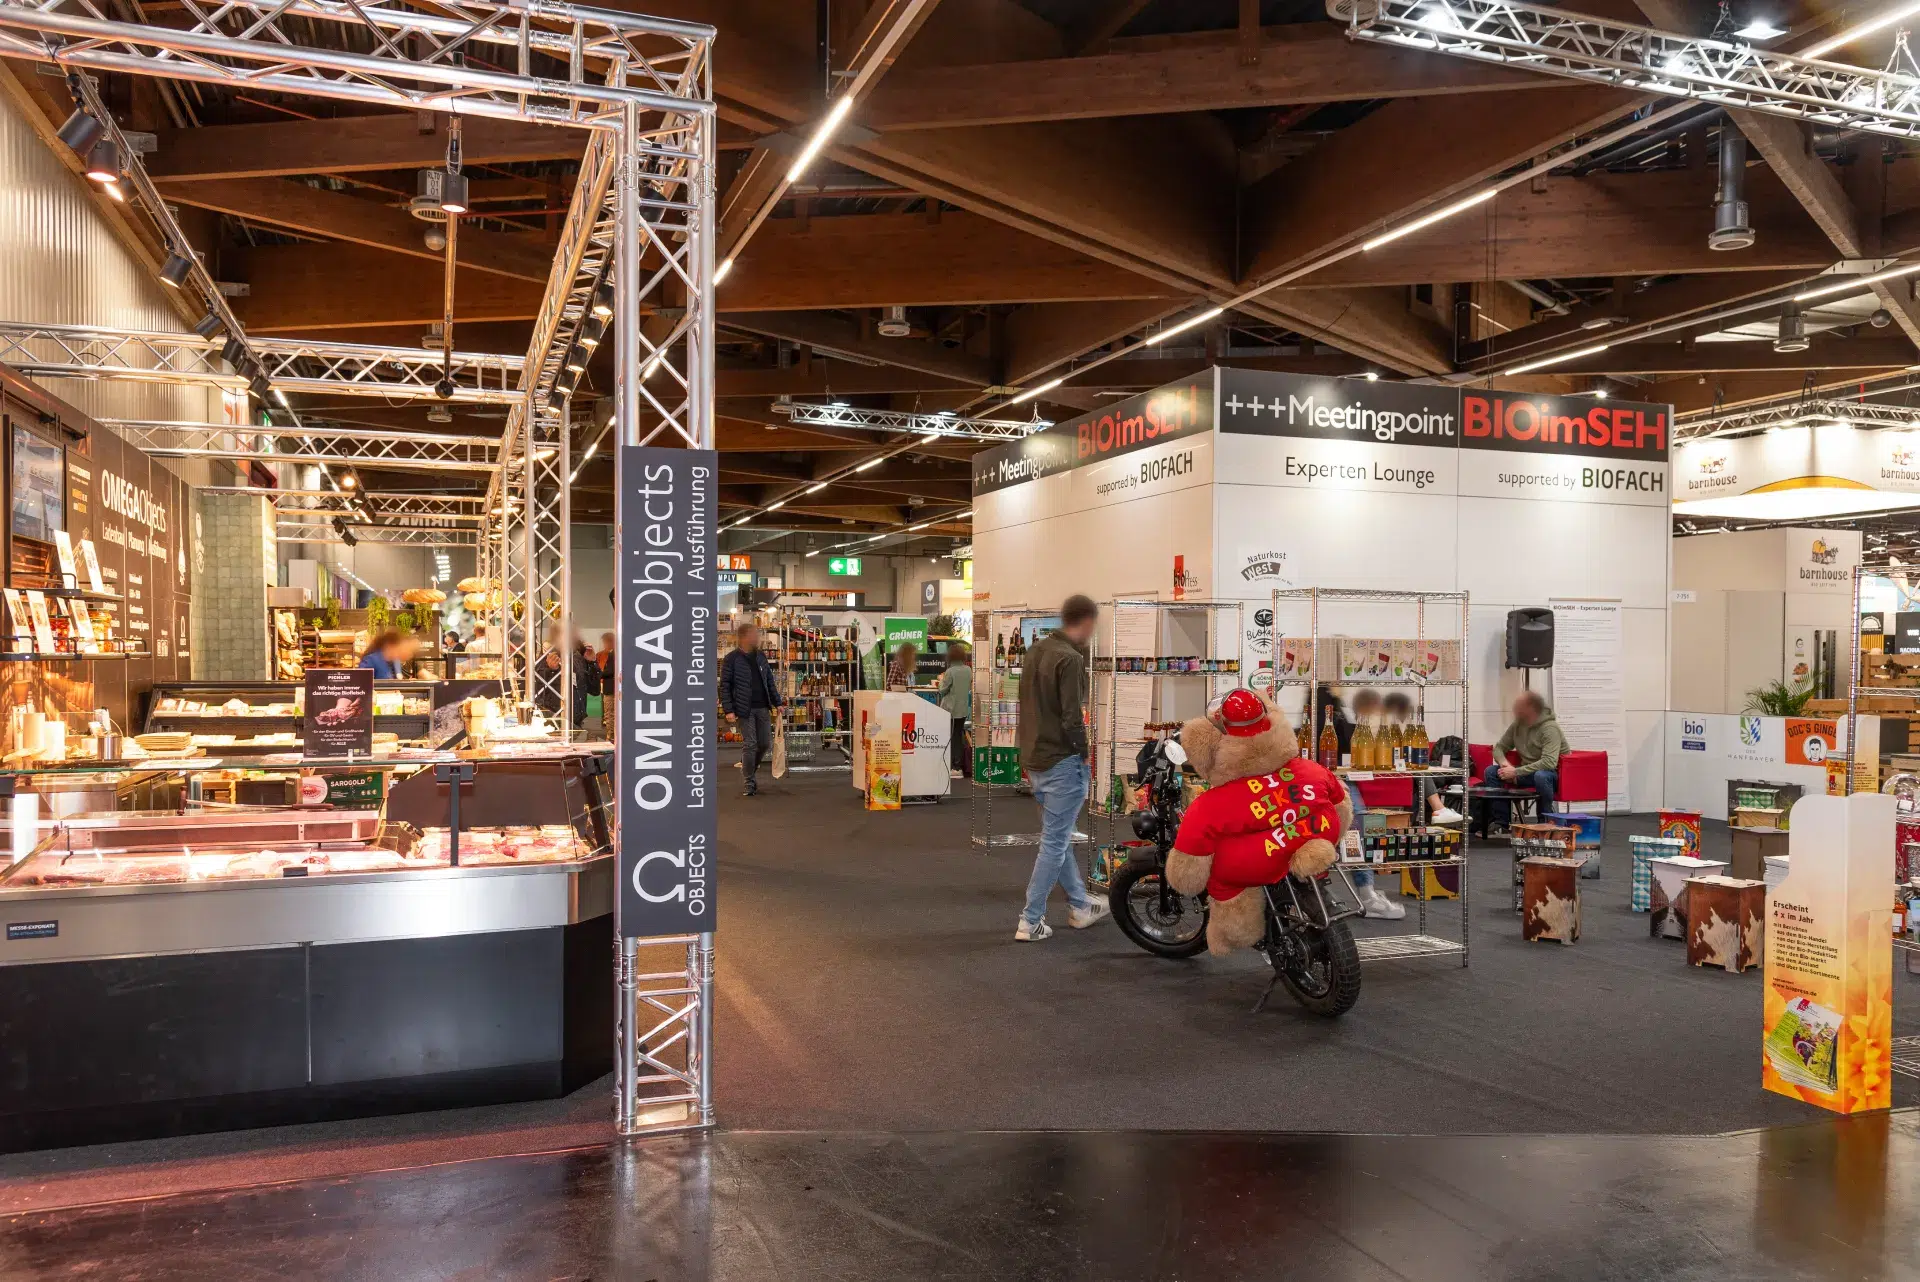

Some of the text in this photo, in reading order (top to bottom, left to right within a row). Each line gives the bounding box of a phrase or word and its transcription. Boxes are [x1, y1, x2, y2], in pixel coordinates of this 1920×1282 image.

[1077, 384, 1197, 459] BIOimSEH
[1464, 396, 1665, 450] BIOimSEH
[1096, 451, 1192, 496] supported by BIOFACH
[1285, 456, 1435, 488] Experten Lounge
[1498, 467, 1664, 492] supported by BIOFACH
[1688, 474, 1737, 490] barnhouse
[1881, 466, 1920, 481] barnhous
[101, 468, 167, 536] OMEGAObjects
[686, 466, 710, 581] Ausführung
[733, 557, 747, 570] 7A
[1247, 550, 1287, 564] Naturkost
[1244, 562, 1274, 579] West
[1800, 566, 1848, 581] barnhouse
[632, 464, 684, 811] OMEGAObjects
[888, 629, 923, 641] GRÜNER
[686, 606, 710, 686] Planung
[914, 658, 946, 668] chmaking
[1684, 720, 1704, 735] bio
[1787, 723, 1811, 738] DOC'S
[686, 712, 705, 808] Ladenbau
[330, 779, 366, 788] SAROGOLD
[1247, 767, 1295, 794] BIG
[1249, 784, 1316, 820] BIKES
[1264, 814, 1331, 857] AFRICA
[688, 834, 706, 916] OBJECTS
[1773, 900, 1809, 913] Erscheint
[1782, 923, 1808, 933] Berichten
[1787, 912, 1797, 921] im
[1798, 914, 1814, 924] Jahr
